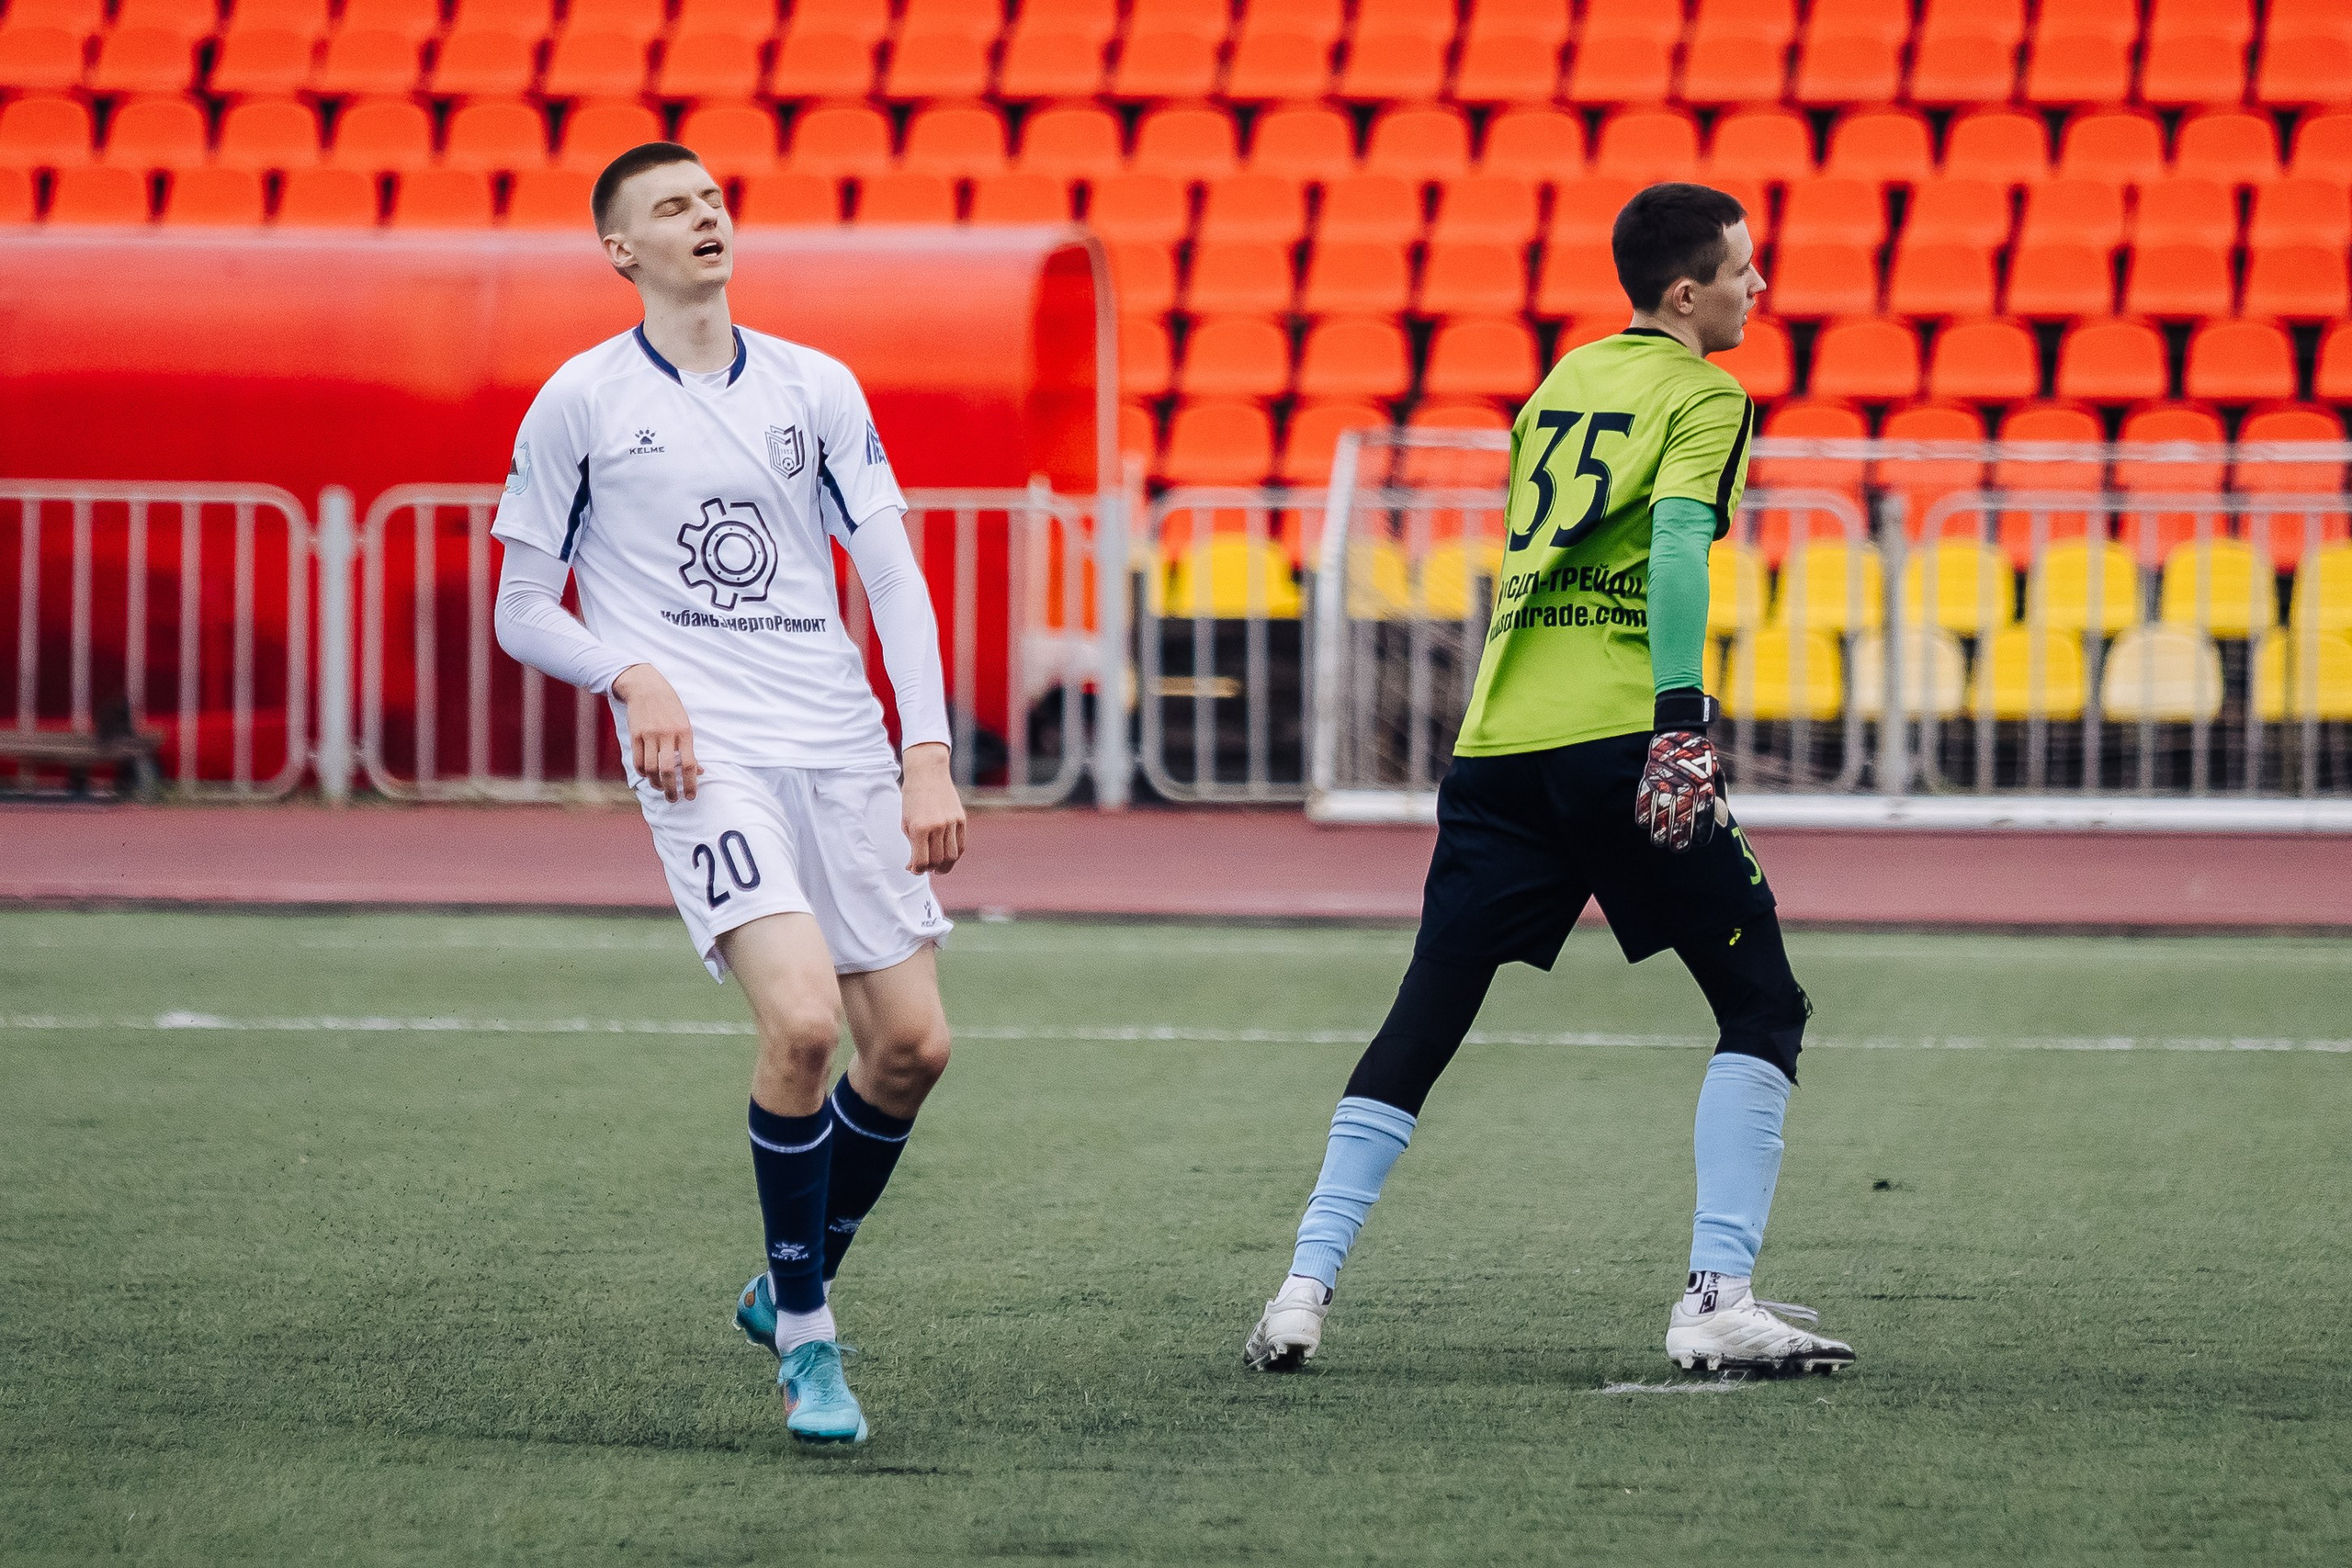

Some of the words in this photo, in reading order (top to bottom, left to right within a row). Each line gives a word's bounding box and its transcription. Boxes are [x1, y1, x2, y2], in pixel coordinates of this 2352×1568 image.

[629, 446, 665, 456] KELME
[1509, 410, 1635, 551] 35
[692, 829, 761, 911] 20
